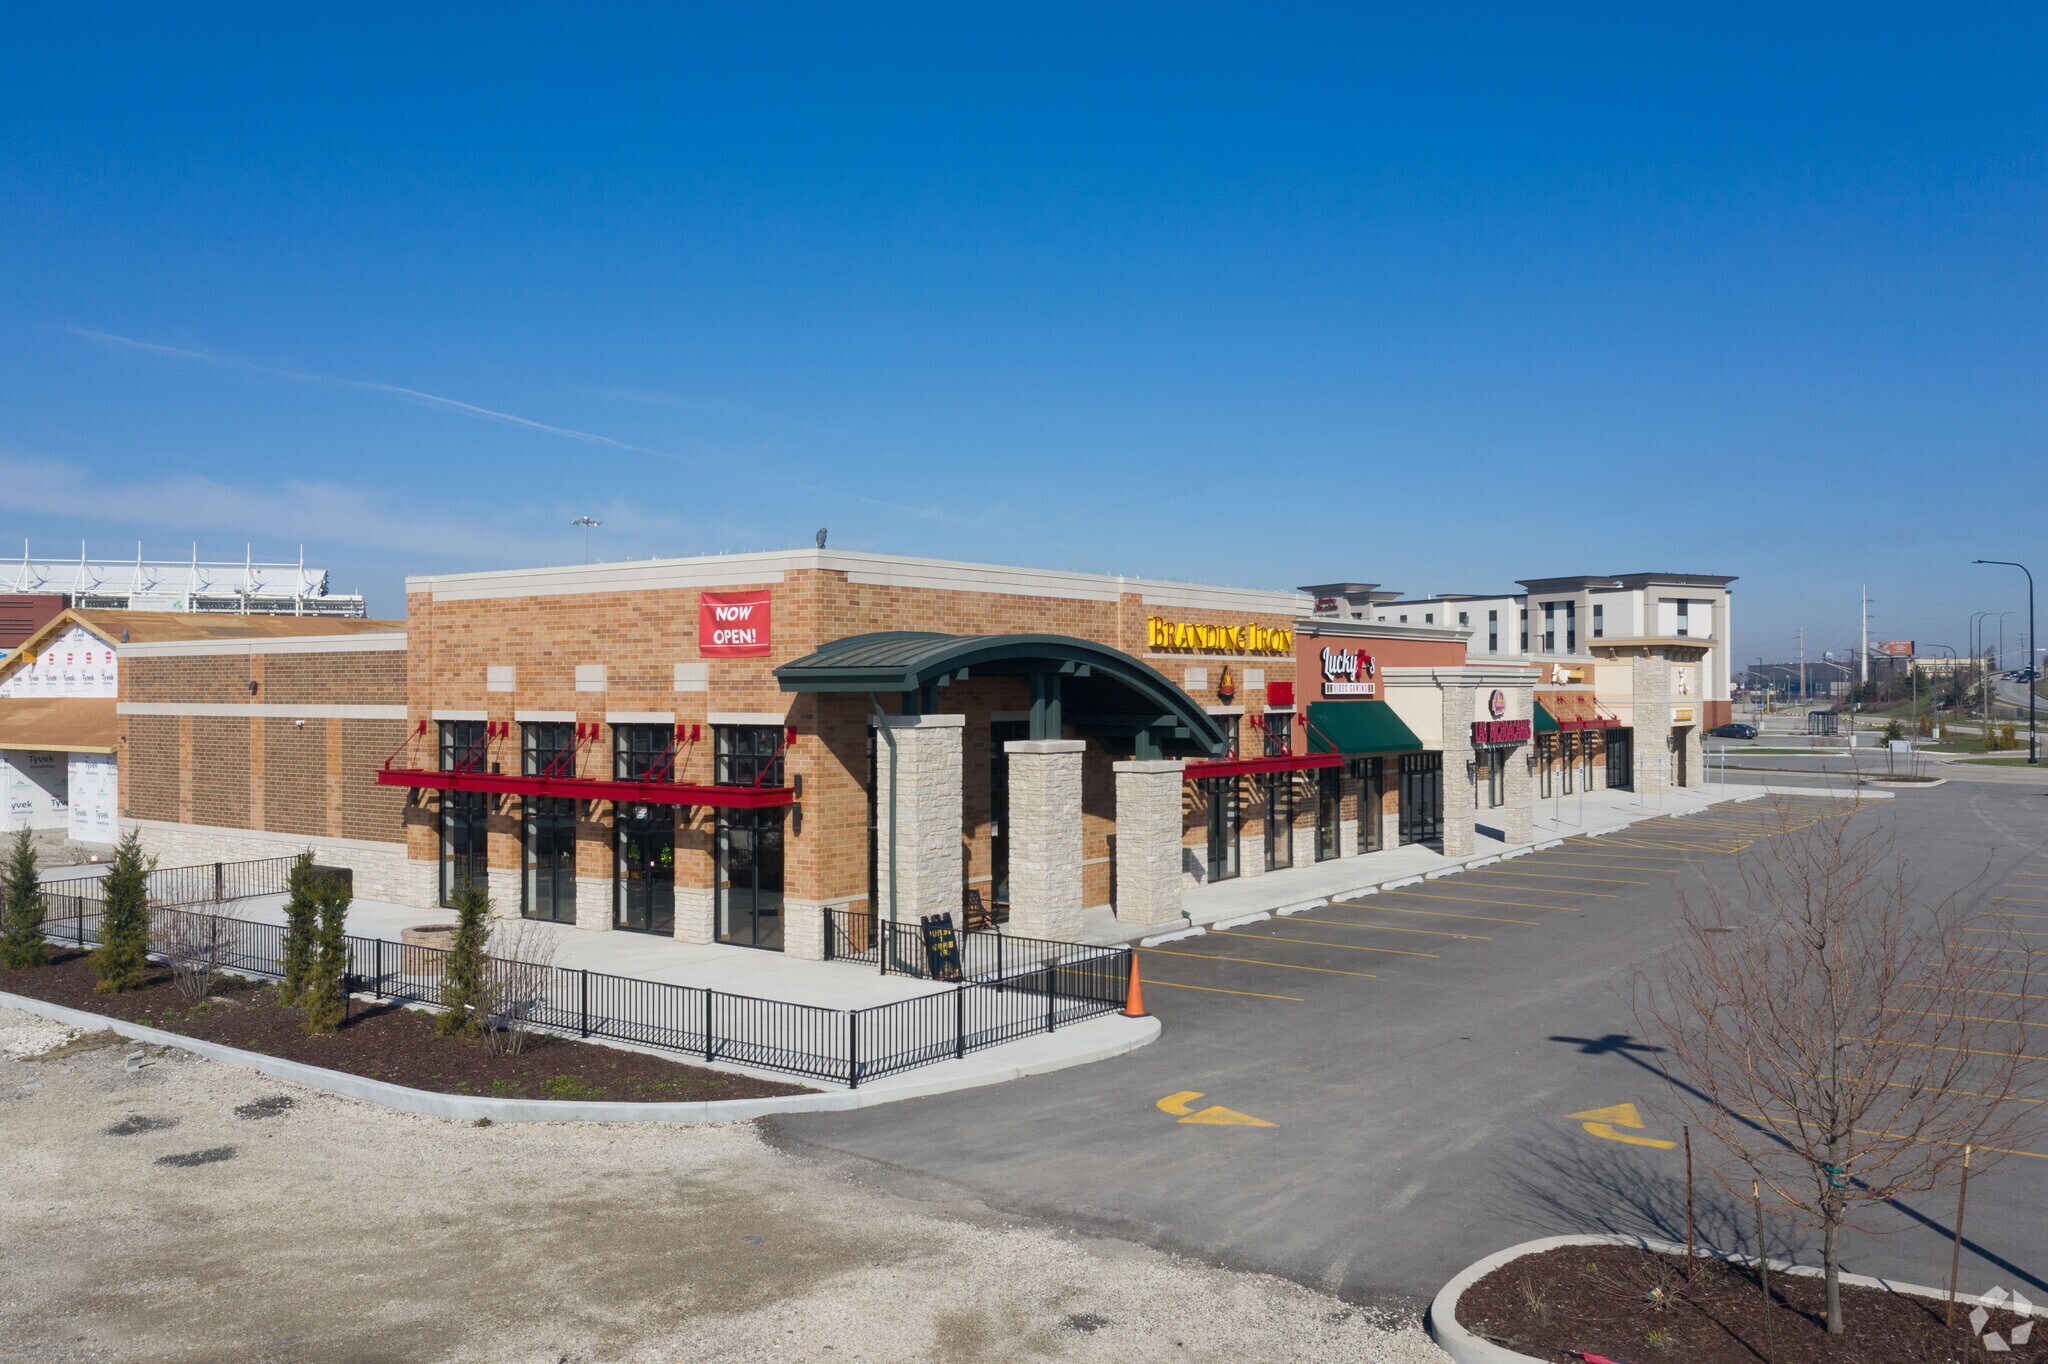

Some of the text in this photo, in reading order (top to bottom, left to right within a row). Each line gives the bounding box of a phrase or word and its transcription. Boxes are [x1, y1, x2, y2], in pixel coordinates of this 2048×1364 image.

[716, 606, 753, 621] NOW
[713, 628, 756, 644] OPEN!
[1149, 616, 1291, 651] BRANDING IRON
[29, 674, 39, 683] Tyvek
[45, 674, 57, 683] Tyvek
[62, 674, 75, 683] Tyvek
[82, 673, 94, 682] Tyvek
[101, 673, 114, 682] Tyvek
[1476, 721, 1487, 743] LAS
[29, 755, 54, 764] Tyvek
[11, 801, 32, 810] yvek
[75, 808, 87, 818] Tyvek
[96, 810, 108, 820] Tyvek
